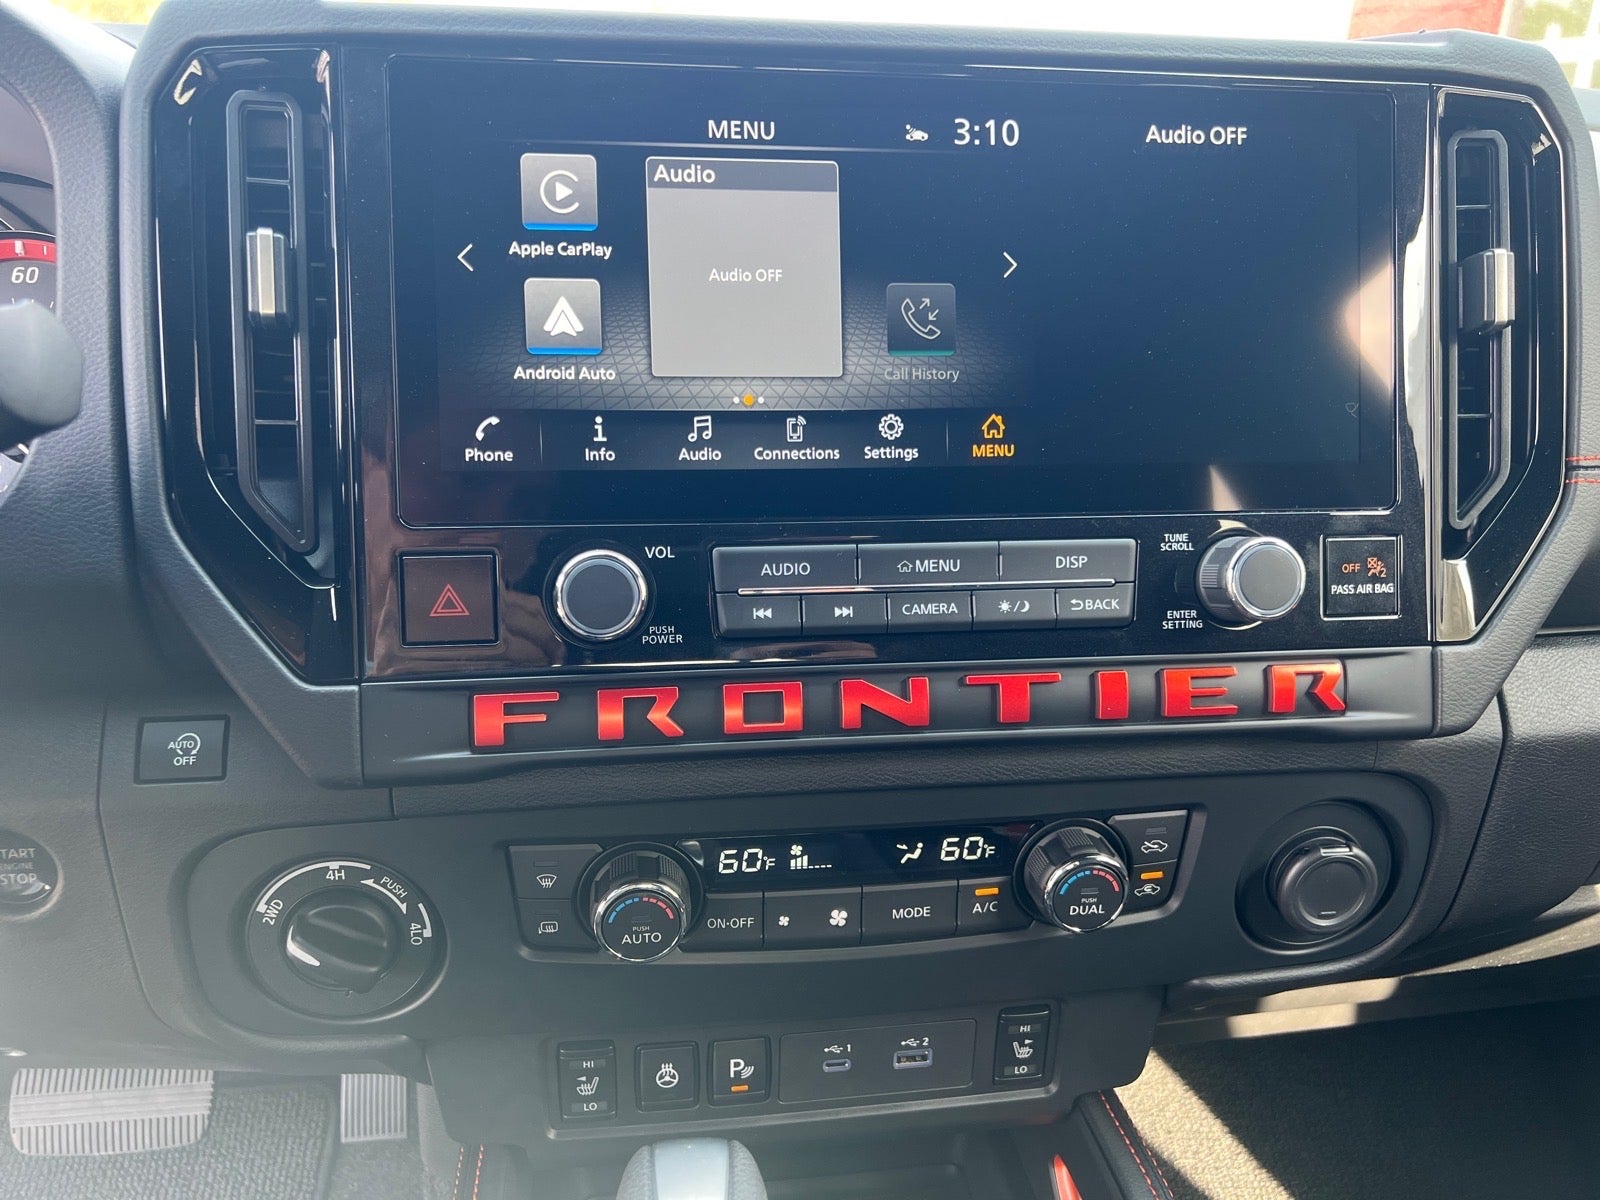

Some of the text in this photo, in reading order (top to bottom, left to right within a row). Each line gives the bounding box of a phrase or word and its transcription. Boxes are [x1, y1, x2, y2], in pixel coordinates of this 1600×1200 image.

[707, 119, 776, 141] MENU
[952, 118, 1021, 148] 3:10
[1145, 124, 1248, 146] Audio OFF
[653, 163, 716, 184] Audio
[508, 240, 613, 261] Apple CarPlay
[11, 266, 40, 284] 60
[708, 267, 783, 283] Audio OFF
[513, 365, 617, 382] Android Auto
[883, 366, 960, 384] Call History
[464, 447, 514, 463] Phone
[584, 447, 616, 463] Info
[678, 446, 722, 462] Audio
[753, 446, 841, 461] Connections
[864, 445, 919, 462] Settings
[971, 444, 1015, 459] MENU
[1163, 533, 1189, 542] TUNE
[644, 546, 676, 559] VOL
[1160, 542, 1195, 551] SCROLL
[915, 559, 961, 573] MENU
[1055, 555, 1089, 569] DISP
[1341, 563, 1361, 574] OFF
[760, 562, 811, 577] AUDIO
[1331, 583, 1394, 595] PASS AIR BAG
[902, 602, 959, 615] CAMERA
[1085, 598, 1120, 611] BACK
[1166, 610, 1197, 620] ENTER
[649, 626, 675, 635] PUSH
[1162, 619, 1204, 630] SETTING
[642, 634, 683, 645] POWER
[473, 661, 1347, 747] FRONTIER
[167, 740, 195, 750] AUTO
[173, 756, 197, 766] OFF
[0, 847, 37, 860] TART
[0, 873, 38, 885] STOP
[325, 869, 346, 881] 4H
[379, 875, 408, 899] PUSH
[262, 898, 284, 926] 2WD
[892, 905, 931, 919] MODE
[972, 900, 998, 914] A/C
[1069, 903, 1106, 916] DUAL
[409, 922, 423, 946] 4LO
[621, 931, 662, 945] AUTO
[1019, 1024, 1032, 1033] HI
[846, 1043, 852, 1053] 1
[922, 1036, 930, 1047] 2
[582, 1060, 595, 1069] HI
[1014, 1065, 1028, 1074] LO
[583, 1102, 598, 1111] LO
